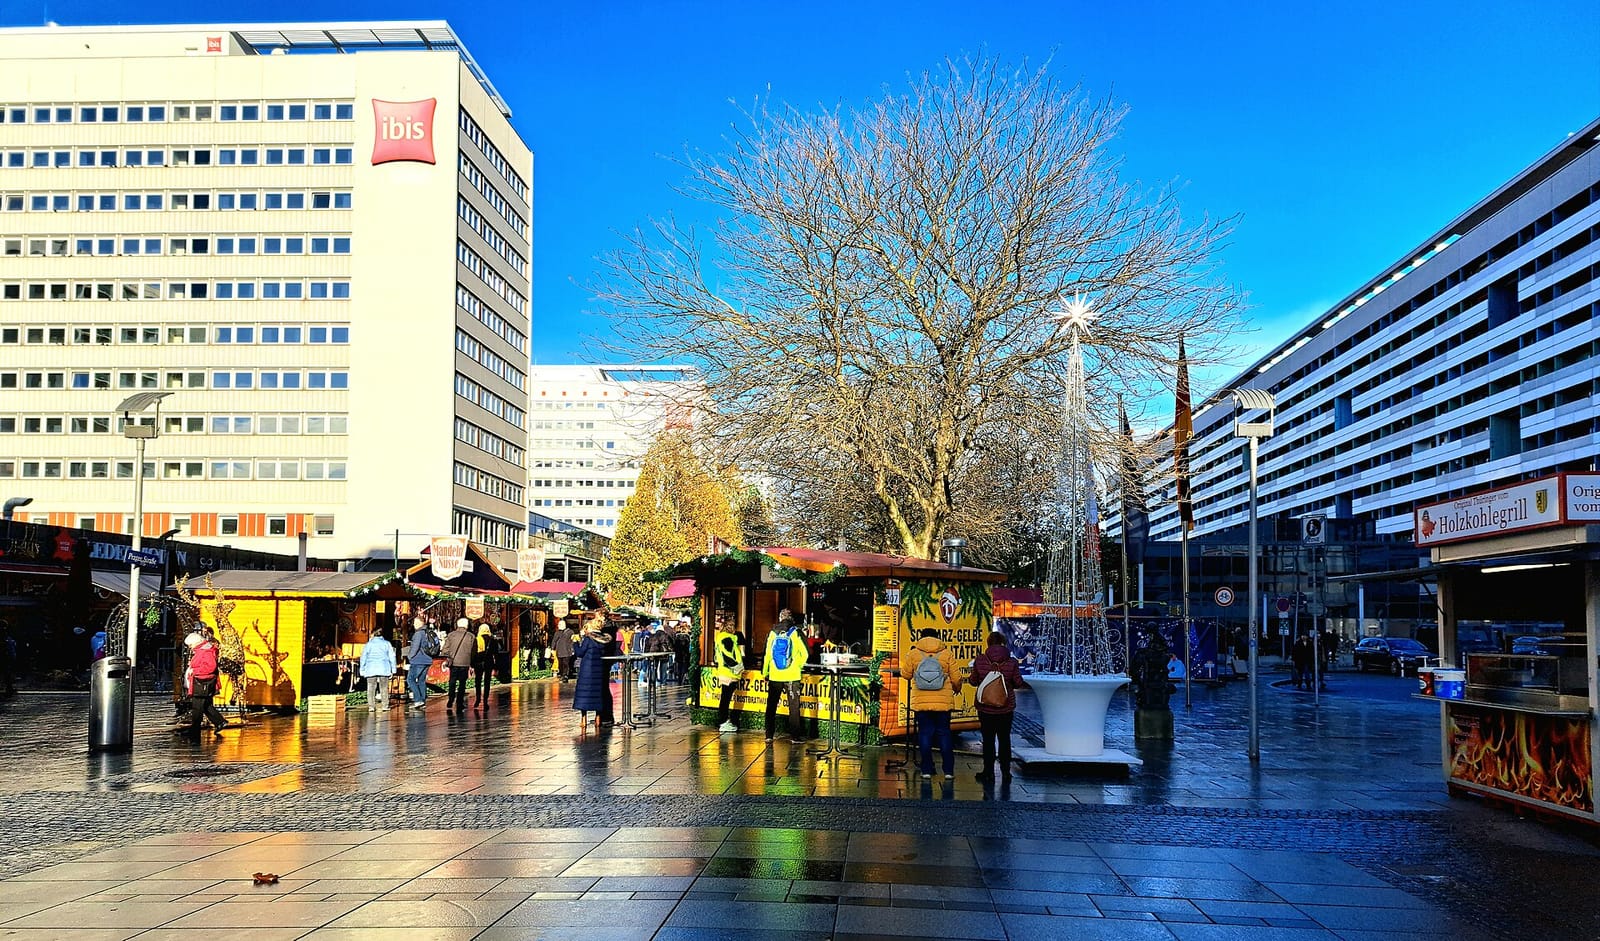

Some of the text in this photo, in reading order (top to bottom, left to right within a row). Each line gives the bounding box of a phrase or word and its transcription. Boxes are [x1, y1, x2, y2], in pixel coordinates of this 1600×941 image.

[382, 116, 425, 141] ibis
[1439, 498, 1528, 534] Holzkohlegrill
[433, 545, 463, 557] Mandeln
[911, 629, 983, 642] SCARZ-GELBE
